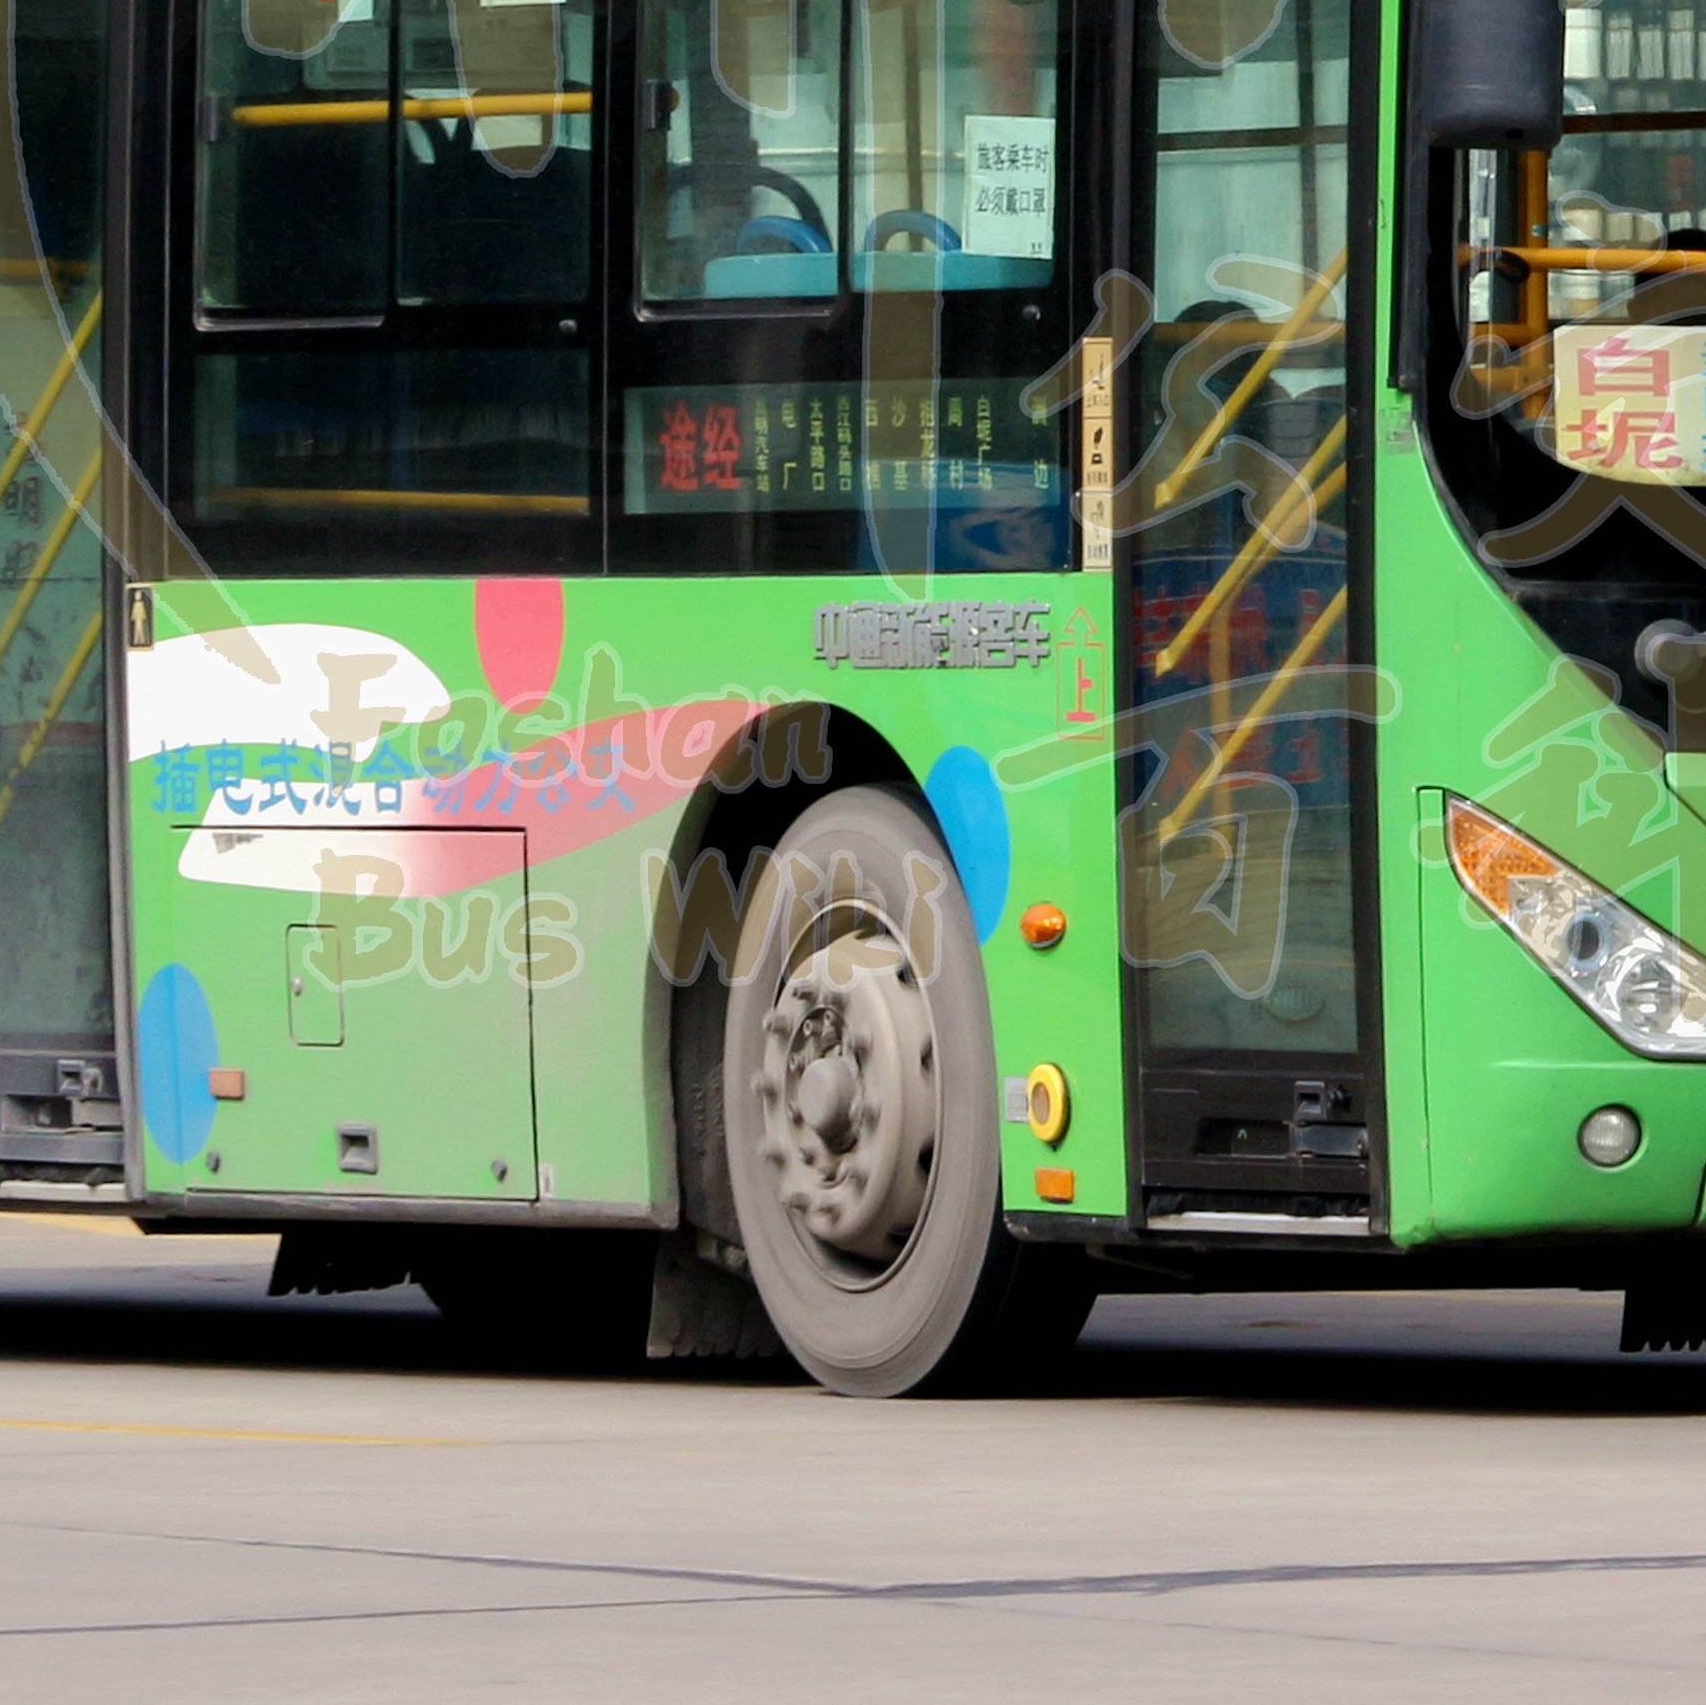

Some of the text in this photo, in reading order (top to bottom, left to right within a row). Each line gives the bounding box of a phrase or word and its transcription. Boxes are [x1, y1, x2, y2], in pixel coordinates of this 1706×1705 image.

[660, 398, 742, 491] 途经
[1561, 336, 1683, 470] 白坭
[1065, 657, 1096, 722] 上
[151, 738, 636, 817] 插电式混合动力公交
